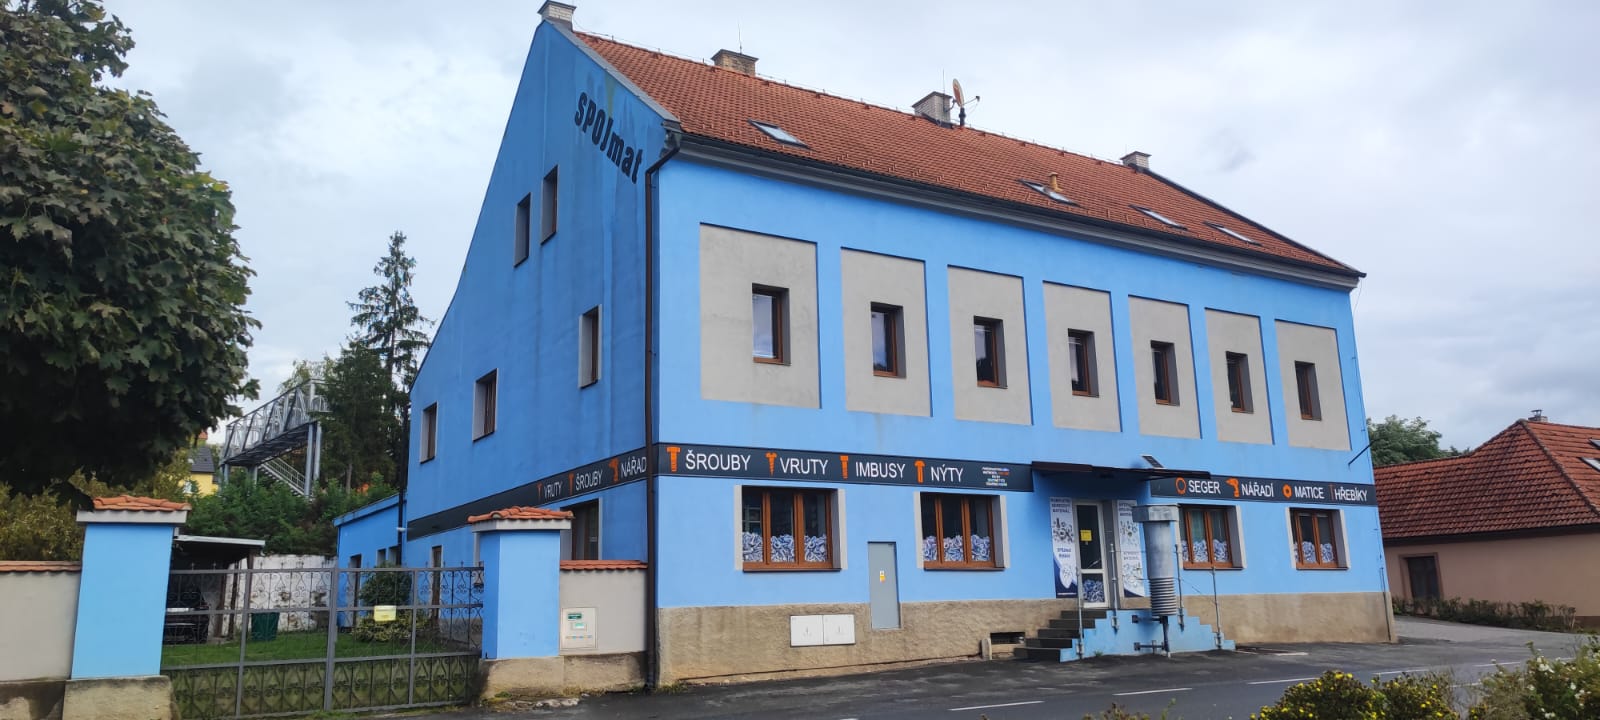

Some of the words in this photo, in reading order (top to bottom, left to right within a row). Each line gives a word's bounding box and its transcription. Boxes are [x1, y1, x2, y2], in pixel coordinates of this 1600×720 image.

[543, 480, 563, 498] VRUTY
[575, 468, 603, 491] ŠROUBY
[620, 455, 647, 478] NÁŘAD
[685, 449, 751, 471] ŠROUBY
[779, 457, 829, 475] VRUTY
[855, 461, 906, 479] IMBUSY
[930, 463, 964, 482] NÝTY
[1188, 479, 1221, 495] SEGER
[1241, 481, 1275, 498] NÁŘADÍ
[1294, 485, 1325, 500] MATICE
[1334, 486, 1368, 502] HŘEBÍKY
